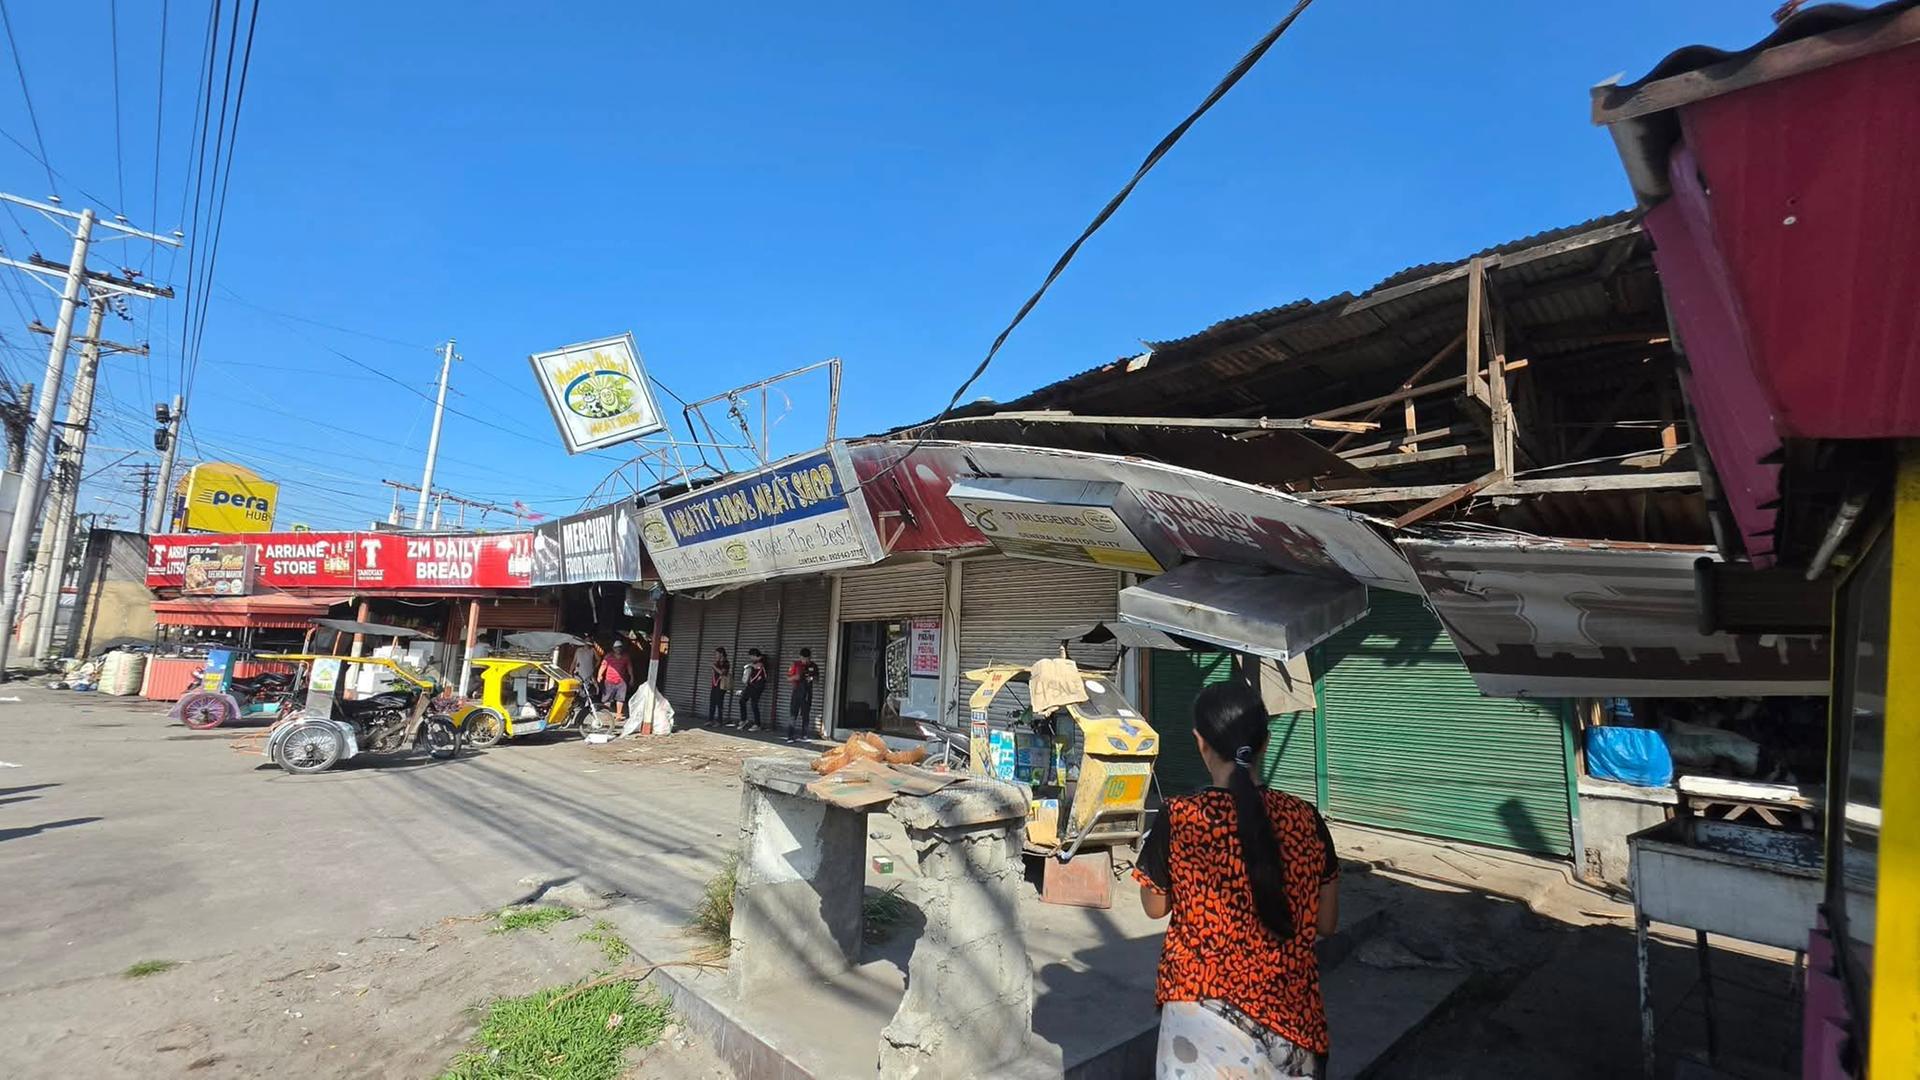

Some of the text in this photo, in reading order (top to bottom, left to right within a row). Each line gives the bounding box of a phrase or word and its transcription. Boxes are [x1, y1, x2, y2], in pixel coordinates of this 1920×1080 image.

[213, 490, 268, 512] pera
[752, 477, 796, 520] MEAT
[791, 464, 833, 507] SHOP
[246, 510, 268, 521] HUB
[1001, 511, 1086, 527] STARLEGENDS
[1172, 496, 1268, 535] MANOK
[562, 514, 613, 555] MERCURY
[751, 519, 857, 559] Meet The Best!
[1018, 531, 1121, 548] GENERAL SANTOS CITY
[1173, 513, 1261, 549] HOUSE
[265, 543, 325, 558] ARRIANE
[407, 538, 481, 560] ZM DAILY
[273, 560, 317, 575] STORE
[416, 562, 473, 579] BREAD
[565, 556, 583, 577] FOOD
